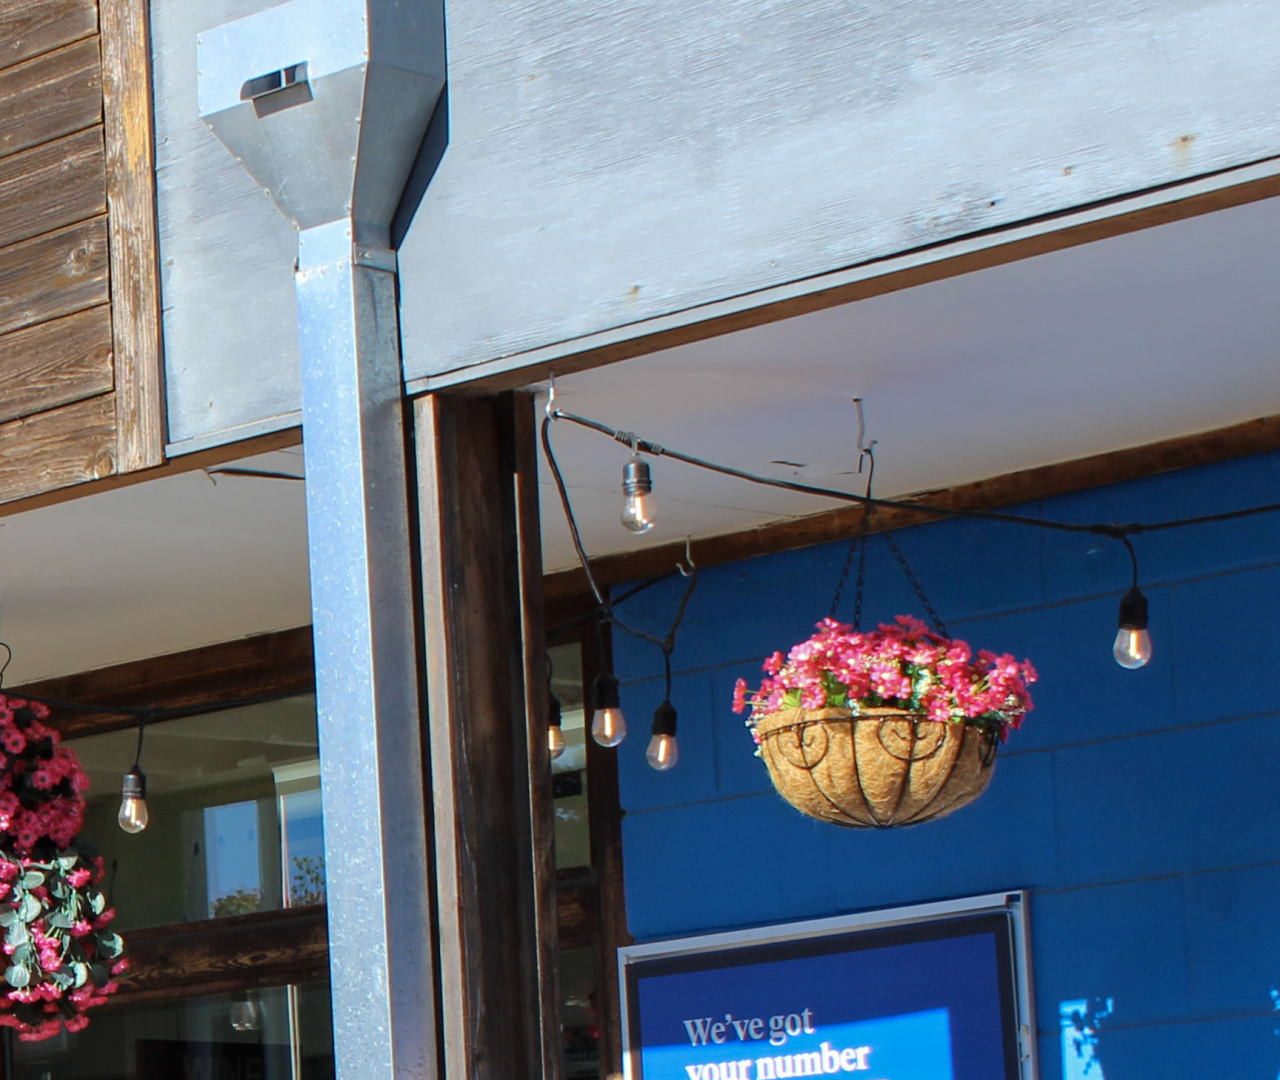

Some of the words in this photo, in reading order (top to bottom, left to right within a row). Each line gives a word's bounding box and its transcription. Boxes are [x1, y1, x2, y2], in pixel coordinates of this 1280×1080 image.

[683, 1014, 764, 1047] We've
[769, 1007, 815, 1046] got
[755, 1043, 870, 1080] number
